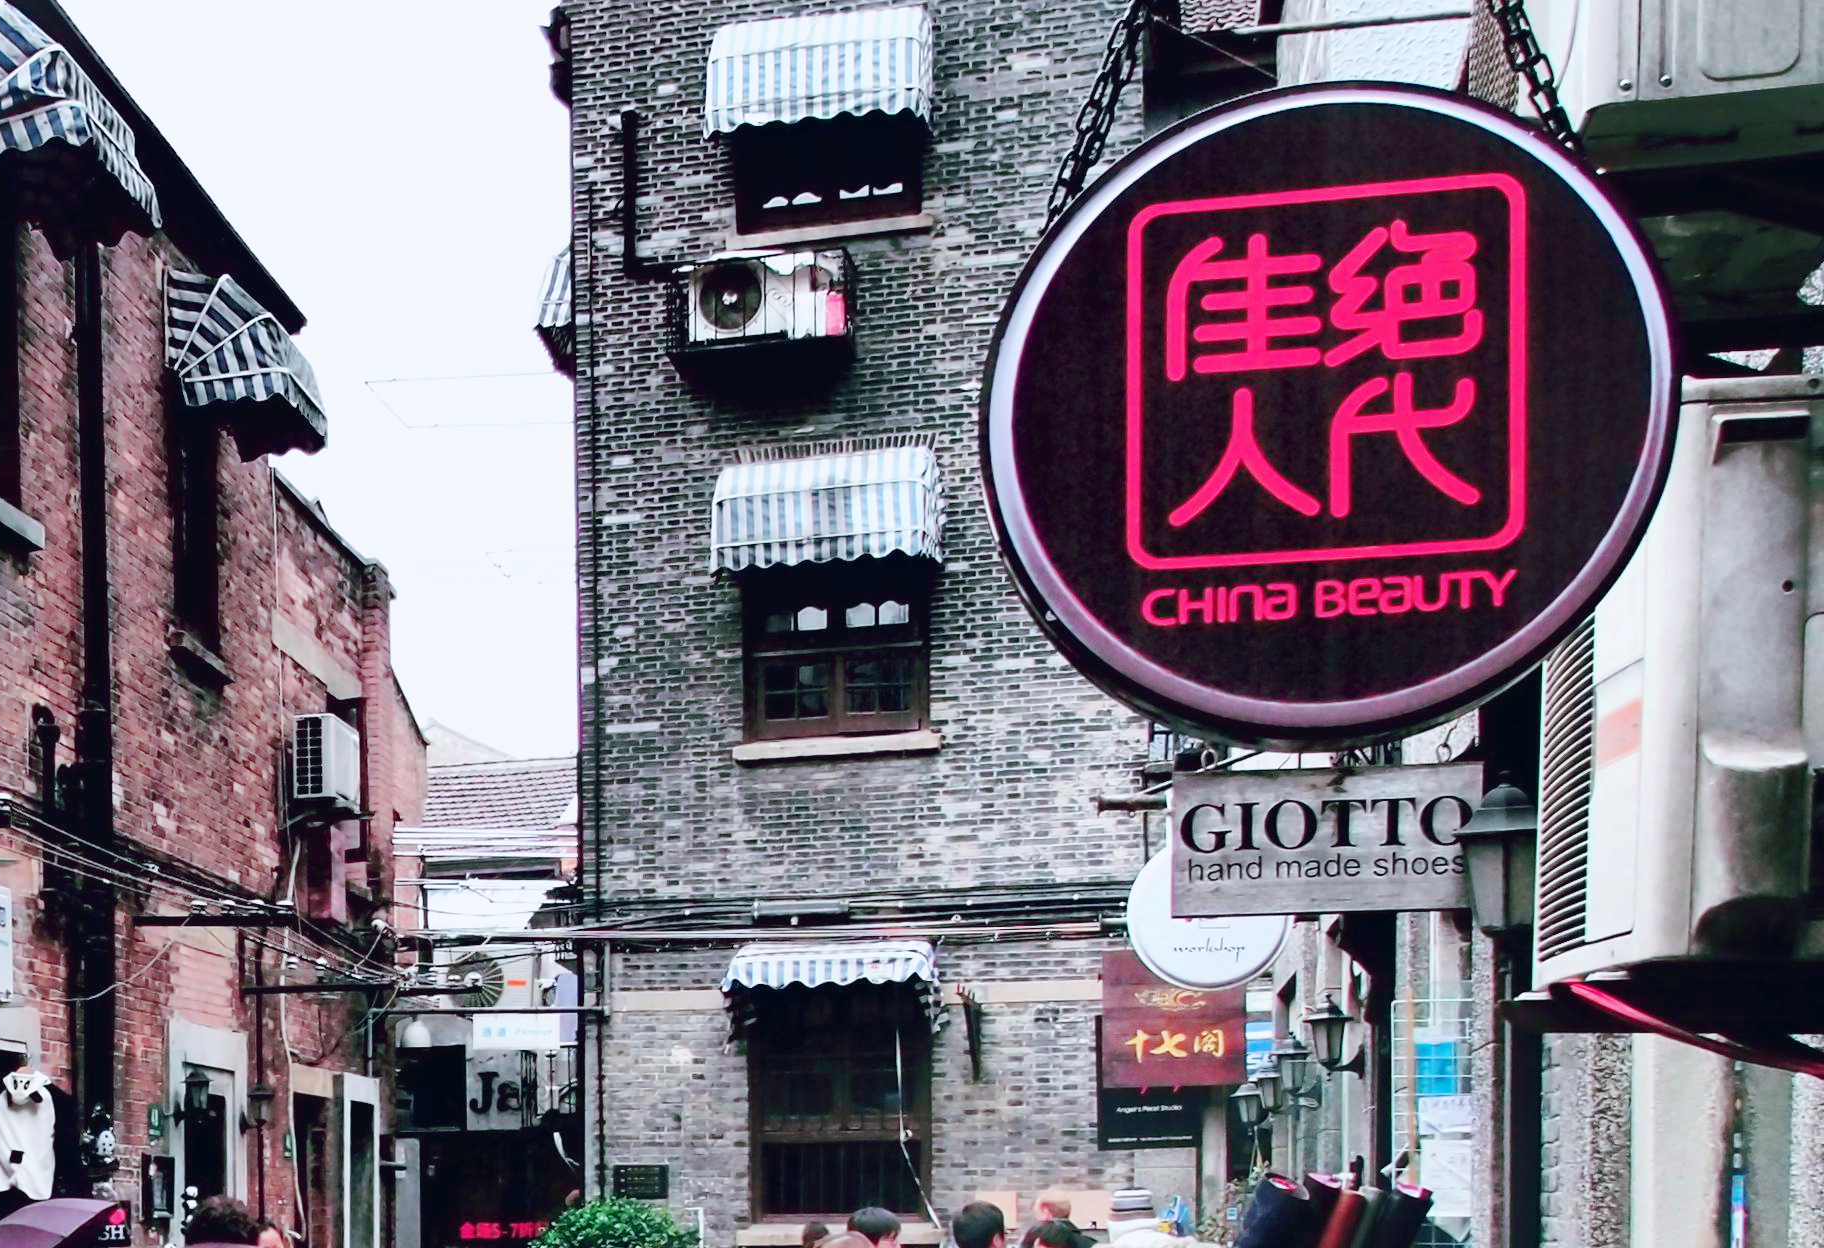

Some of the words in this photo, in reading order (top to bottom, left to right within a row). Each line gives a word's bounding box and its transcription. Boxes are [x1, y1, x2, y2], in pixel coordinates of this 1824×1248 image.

[1180, 795, 1474, 854] GIOTTO
[1188, 856, 1262, 882] hand
[1276, 853, 1361, 879] made
[1372, 851, 1466, 877] shoes
[1174, 936, 1245, 962] workshop
